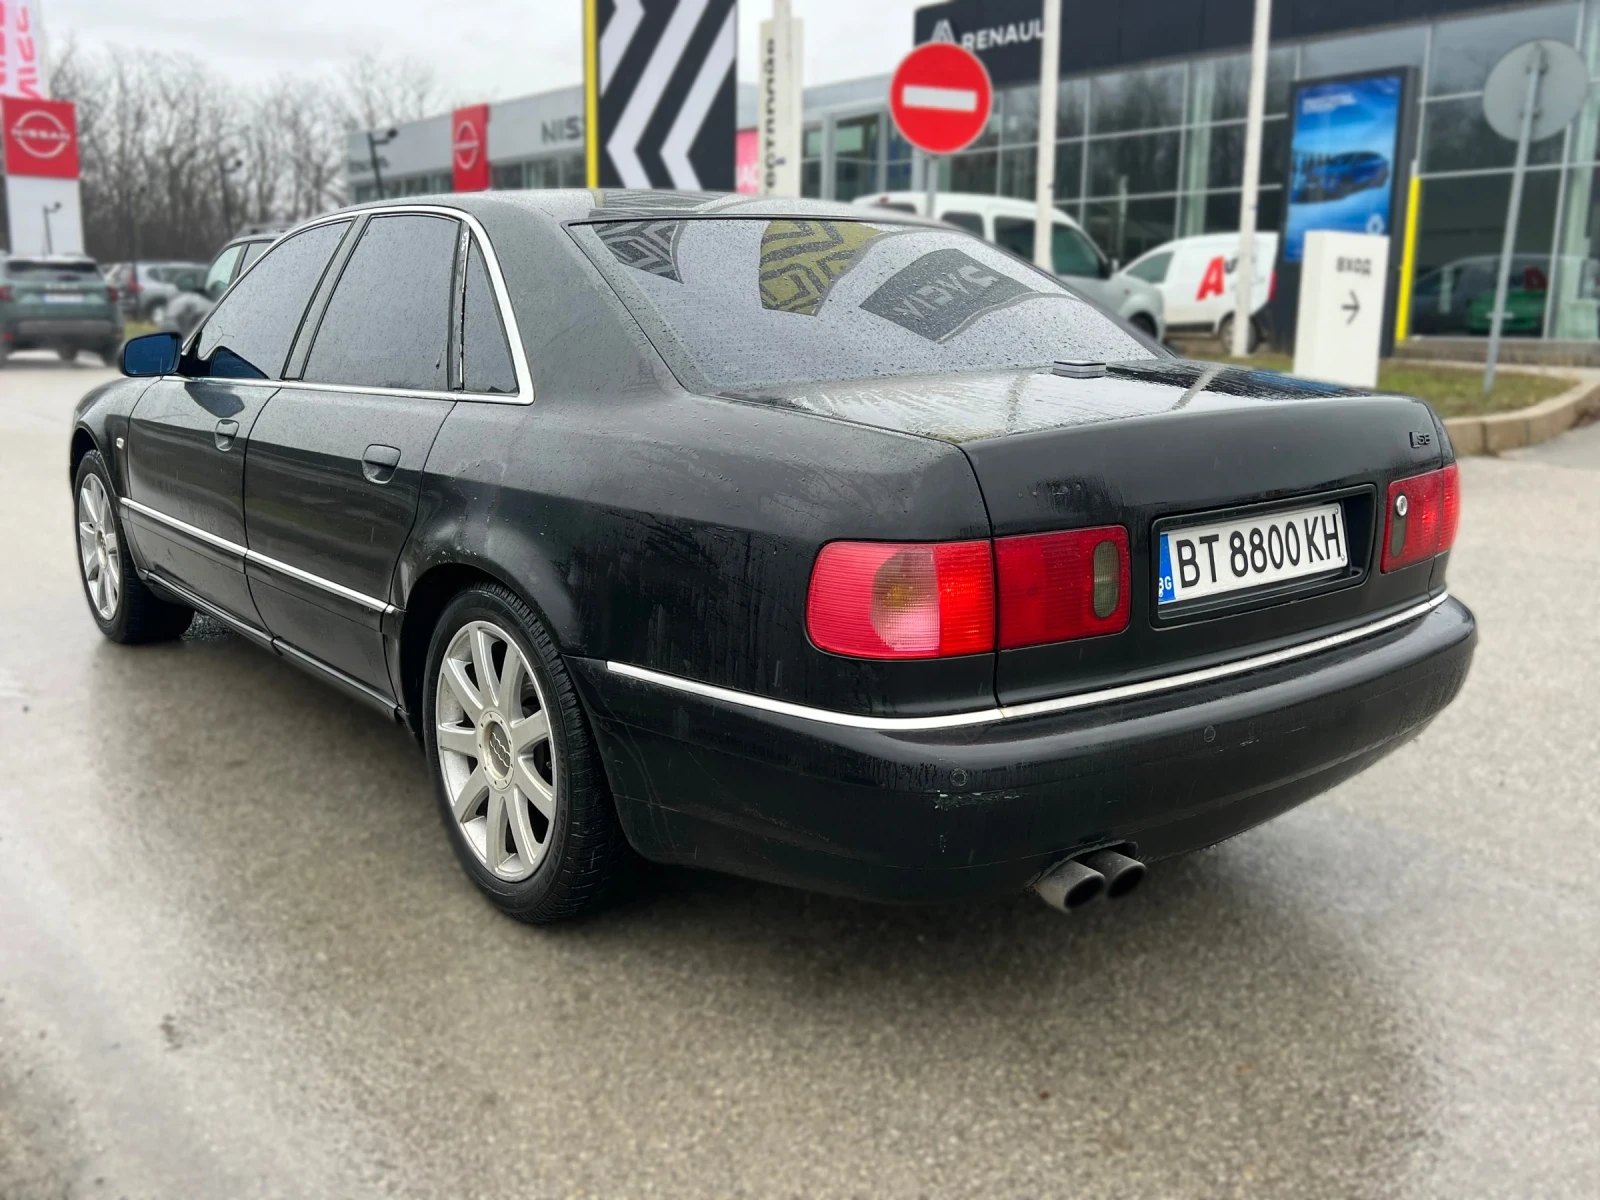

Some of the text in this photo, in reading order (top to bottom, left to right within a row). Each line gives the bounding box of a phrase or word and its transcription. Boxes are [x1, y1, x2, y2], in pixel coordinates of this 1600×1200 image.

[1176, 513, 1342, 589] BT 8800 KH
